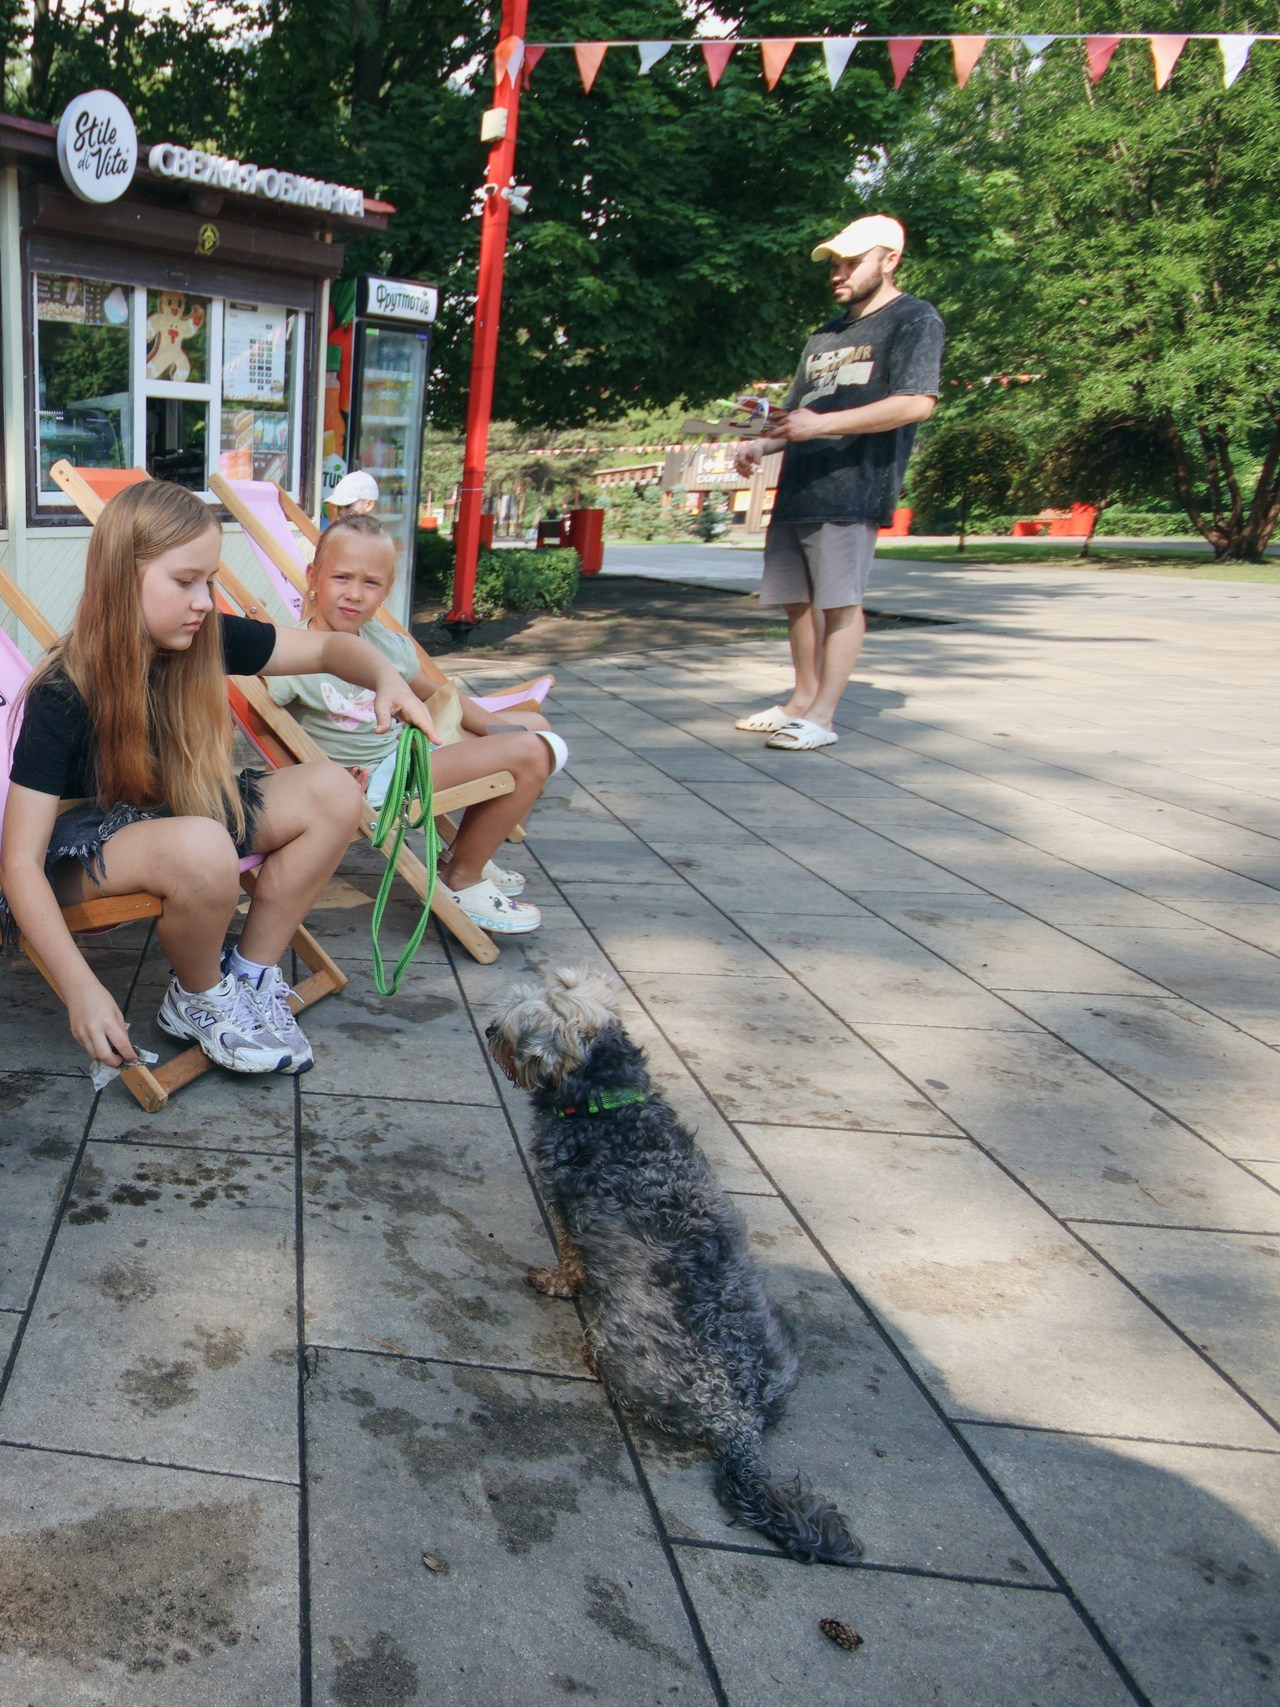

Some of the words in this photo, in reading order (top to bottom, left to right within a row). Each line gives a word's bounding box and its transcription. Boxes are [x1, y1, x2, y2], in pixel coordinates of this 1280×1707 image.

[73, 111, 117, 152] Stile
[77, 149, 91, 173] di
[90, 147, 128, 180] Vita
[150, 142, 258, 194] СВЕЖАЯ
[257, 168, 365, 218] ОБЖАРКА
[469, 914, 513, 931] crocs
